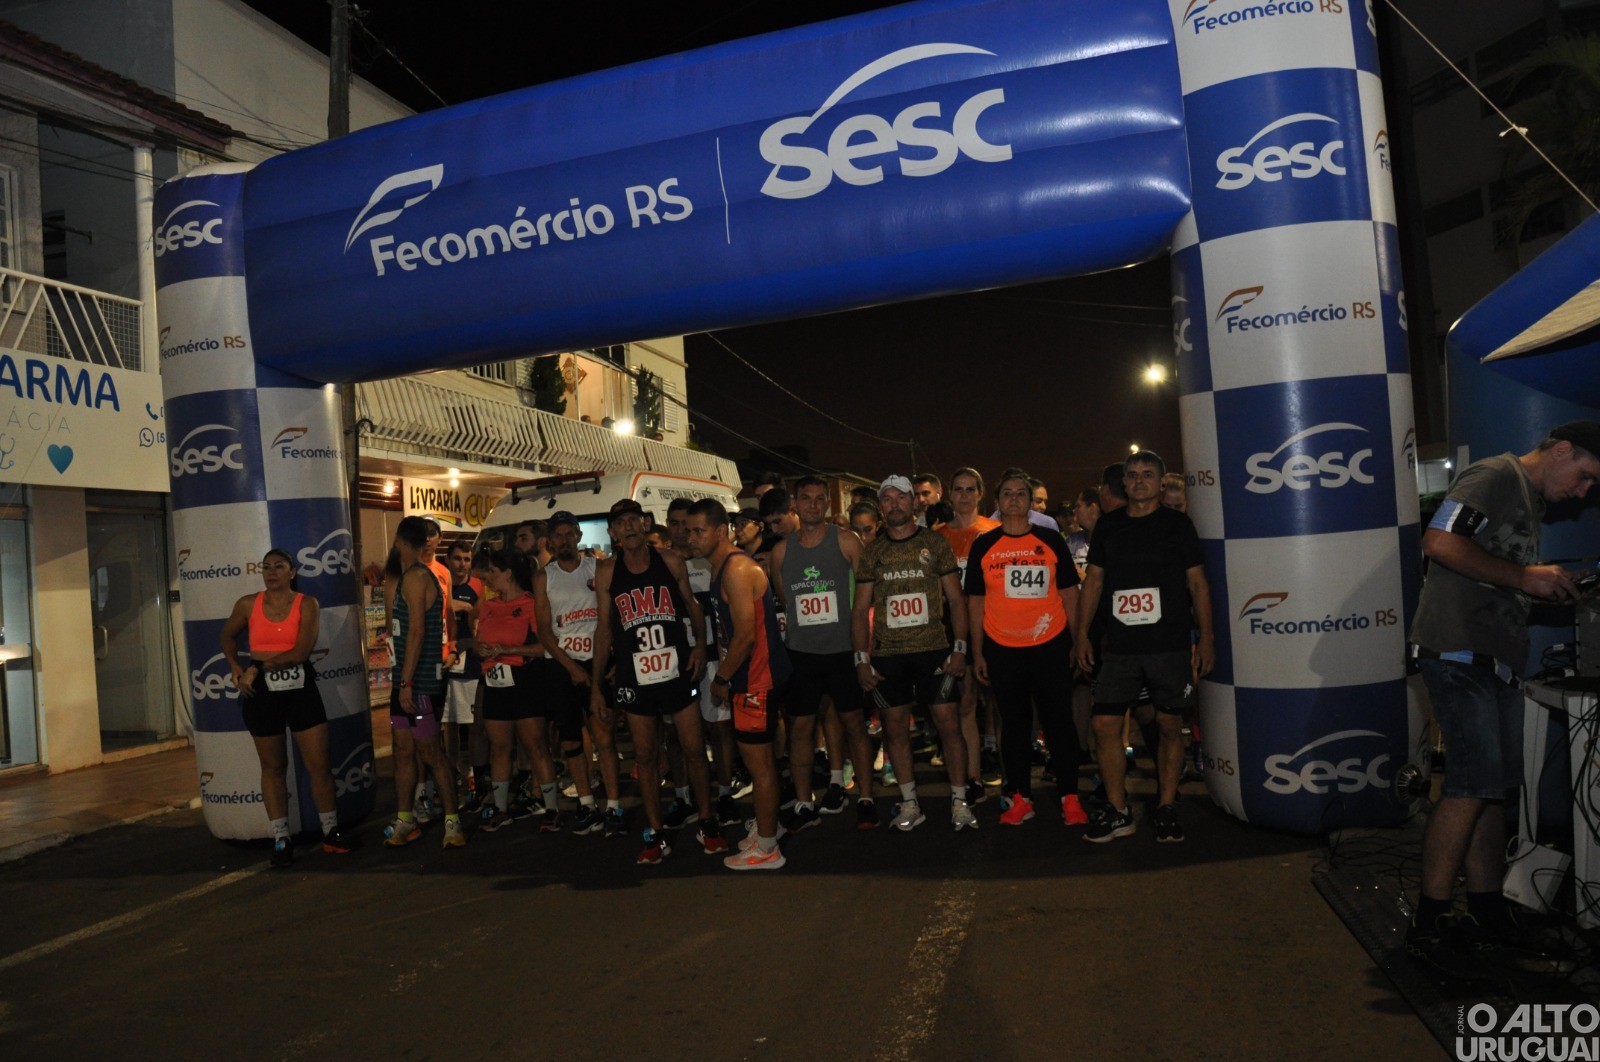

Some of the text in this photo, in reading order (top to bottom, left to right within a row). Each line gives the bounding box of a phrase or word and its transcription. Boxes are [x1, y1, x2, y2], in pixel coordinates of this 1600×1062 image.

[1193, 0, 1314, 35] Fecomércio
[369, 176, 694, 278] Fecomércio RS
[1226, 303, 1347, 334] Fecomércio
[1352, 301, 1376, 320] RS
[223, 335, 246, 349] RS
[1197, 470, 1215, 486] RS
[883, 569, 925, 580] MASSA
[1010, 569, 1045, 588] 844
[800, 596, 830, 616] 301
[889, 597, 923, 618] 300
[1117, 593, 1155, 614] 293
[1249, 608, 1398, 635] Fecomércio RS
[564, 637, 592, 653] 269
[636, 624, 666, 652] 30
[269, 664, 300, 682] 863
[639, 652, 672, 675] 307
[1217, 757, 1235, 776] RS
